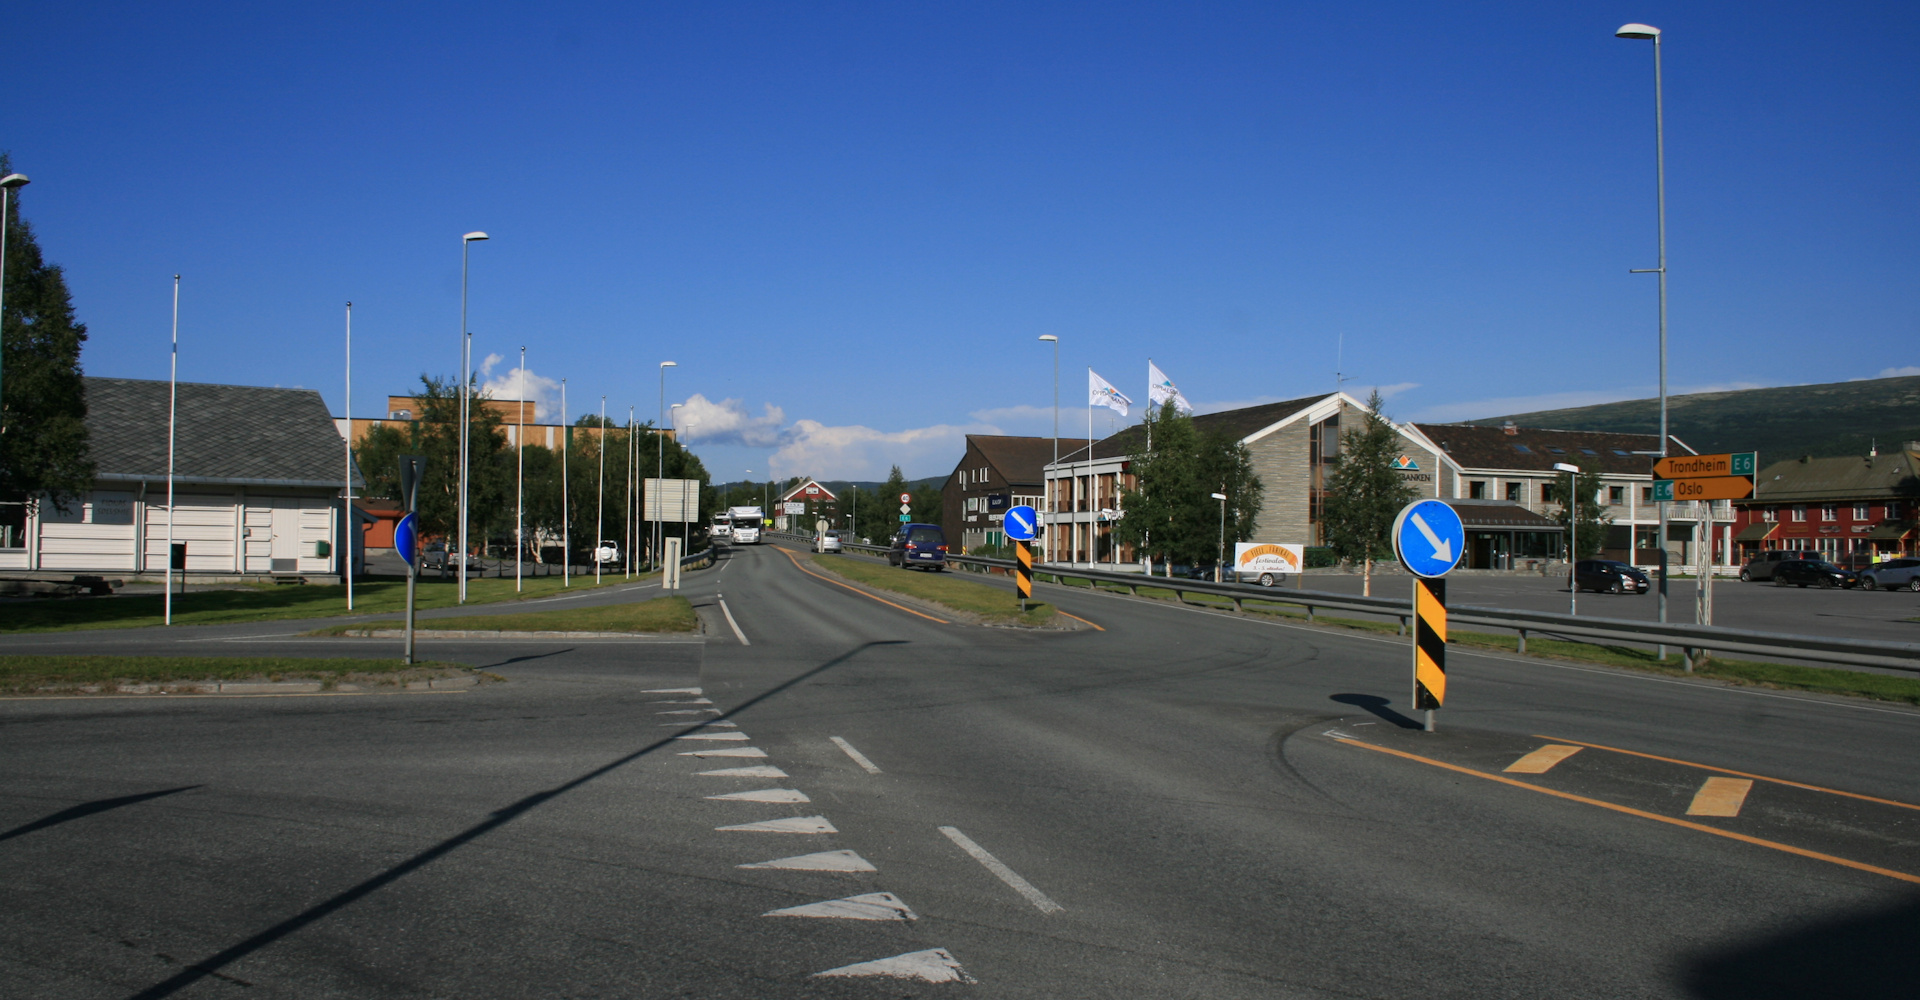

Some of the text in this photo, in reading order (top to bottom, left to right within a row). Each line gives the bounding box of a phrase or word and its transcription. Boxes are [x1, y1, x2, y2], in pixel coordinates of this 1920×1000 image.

[1669, 458, 1751, 473] Trondheim E 6
[1678, 482, 1703, 495] Oslo
